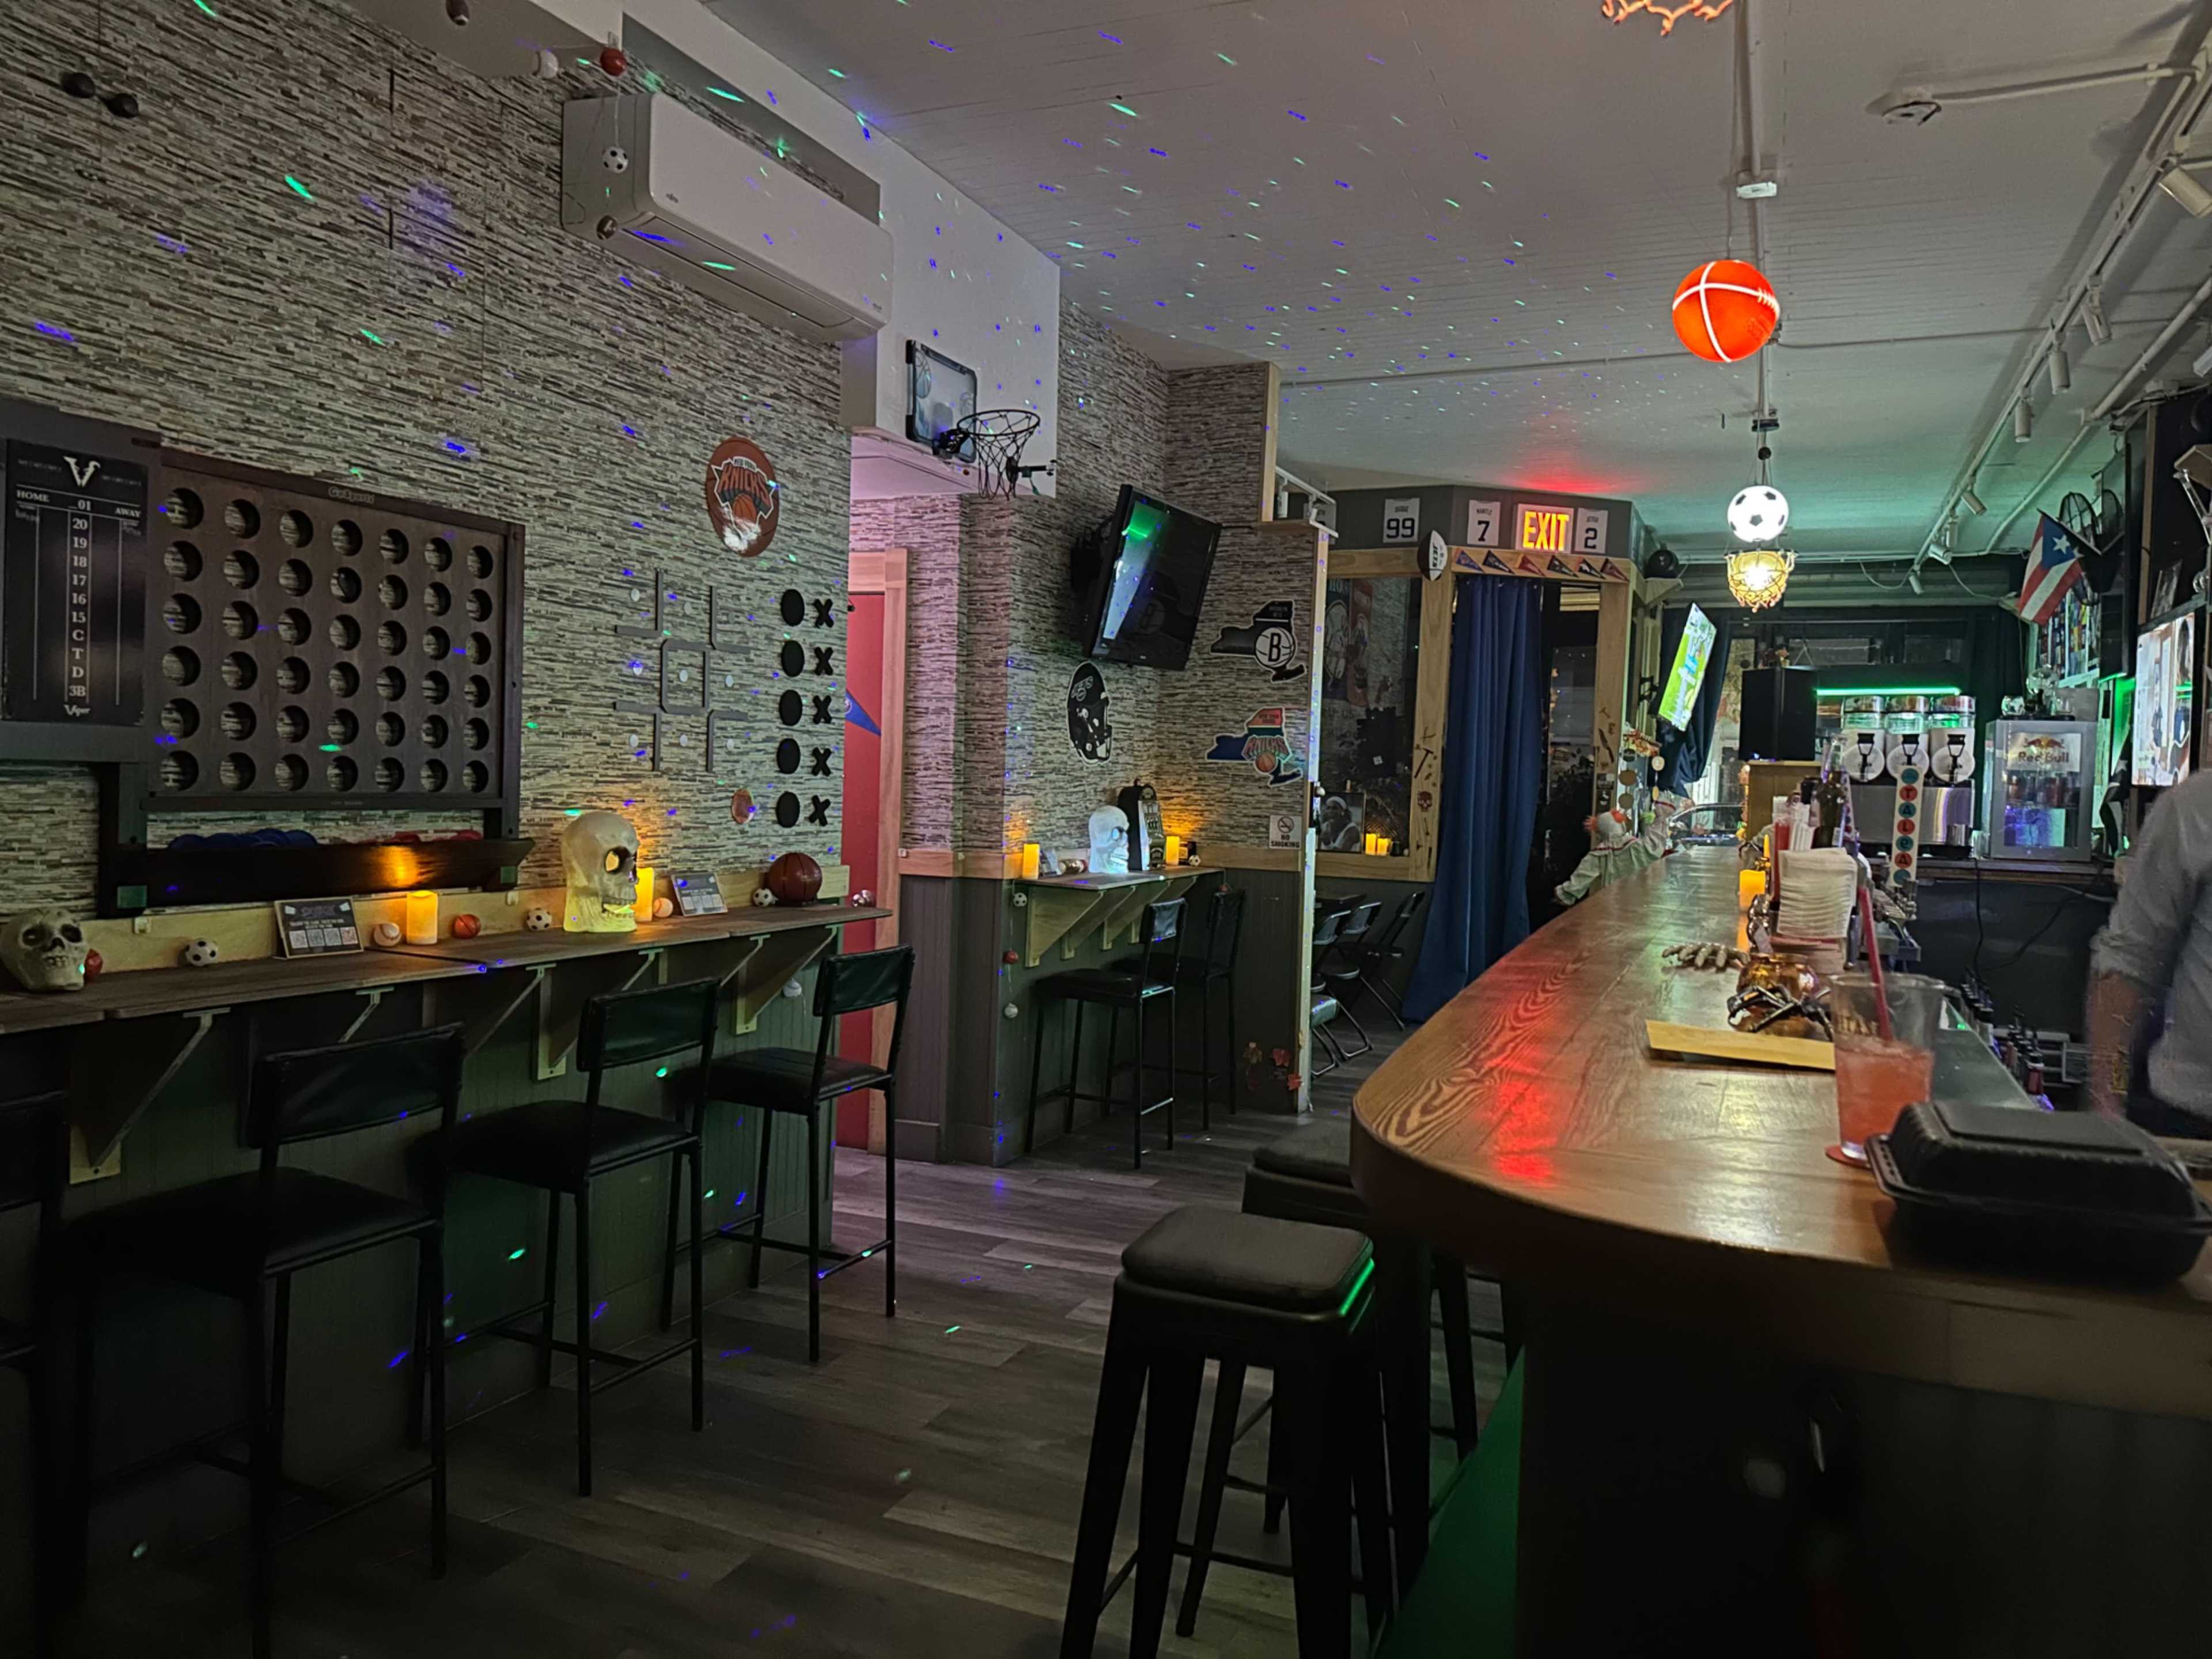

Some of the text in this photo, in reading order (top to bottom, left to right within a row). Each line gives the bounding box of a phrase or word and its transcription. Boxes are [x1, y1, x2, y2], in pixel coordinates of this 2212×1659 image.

[718, 463, 772, 506] KNICKS
[16, 490, 50, 502] HOME
[115, 507, 141, 518] AWAY
[72, 518, 88, 530] 20
[1386, 517, 1415, 539] 99
[1478, 520, 1490, 542] 7
[1522, 510, 1570, 552] EXIT
[73, 536, 88, 548] 19
[1584, 527, 1598, 549] 2
[73, 555, 88, 568] 18
[72, 574, 87, 586] 17
[72, 593, 87, 605] 16
[72, 611, 86, 624] 15
[72, 629, 85, 641] C
[1268, 632, 1282, 662] B
[71, 647, 84, 660] T
[72, 666, 85, 678] D
[69, 685, 86, 697] 3B
[2046, 751, 2069, 763] Bull
[1271, 840, 1300, 849] SMOKING
